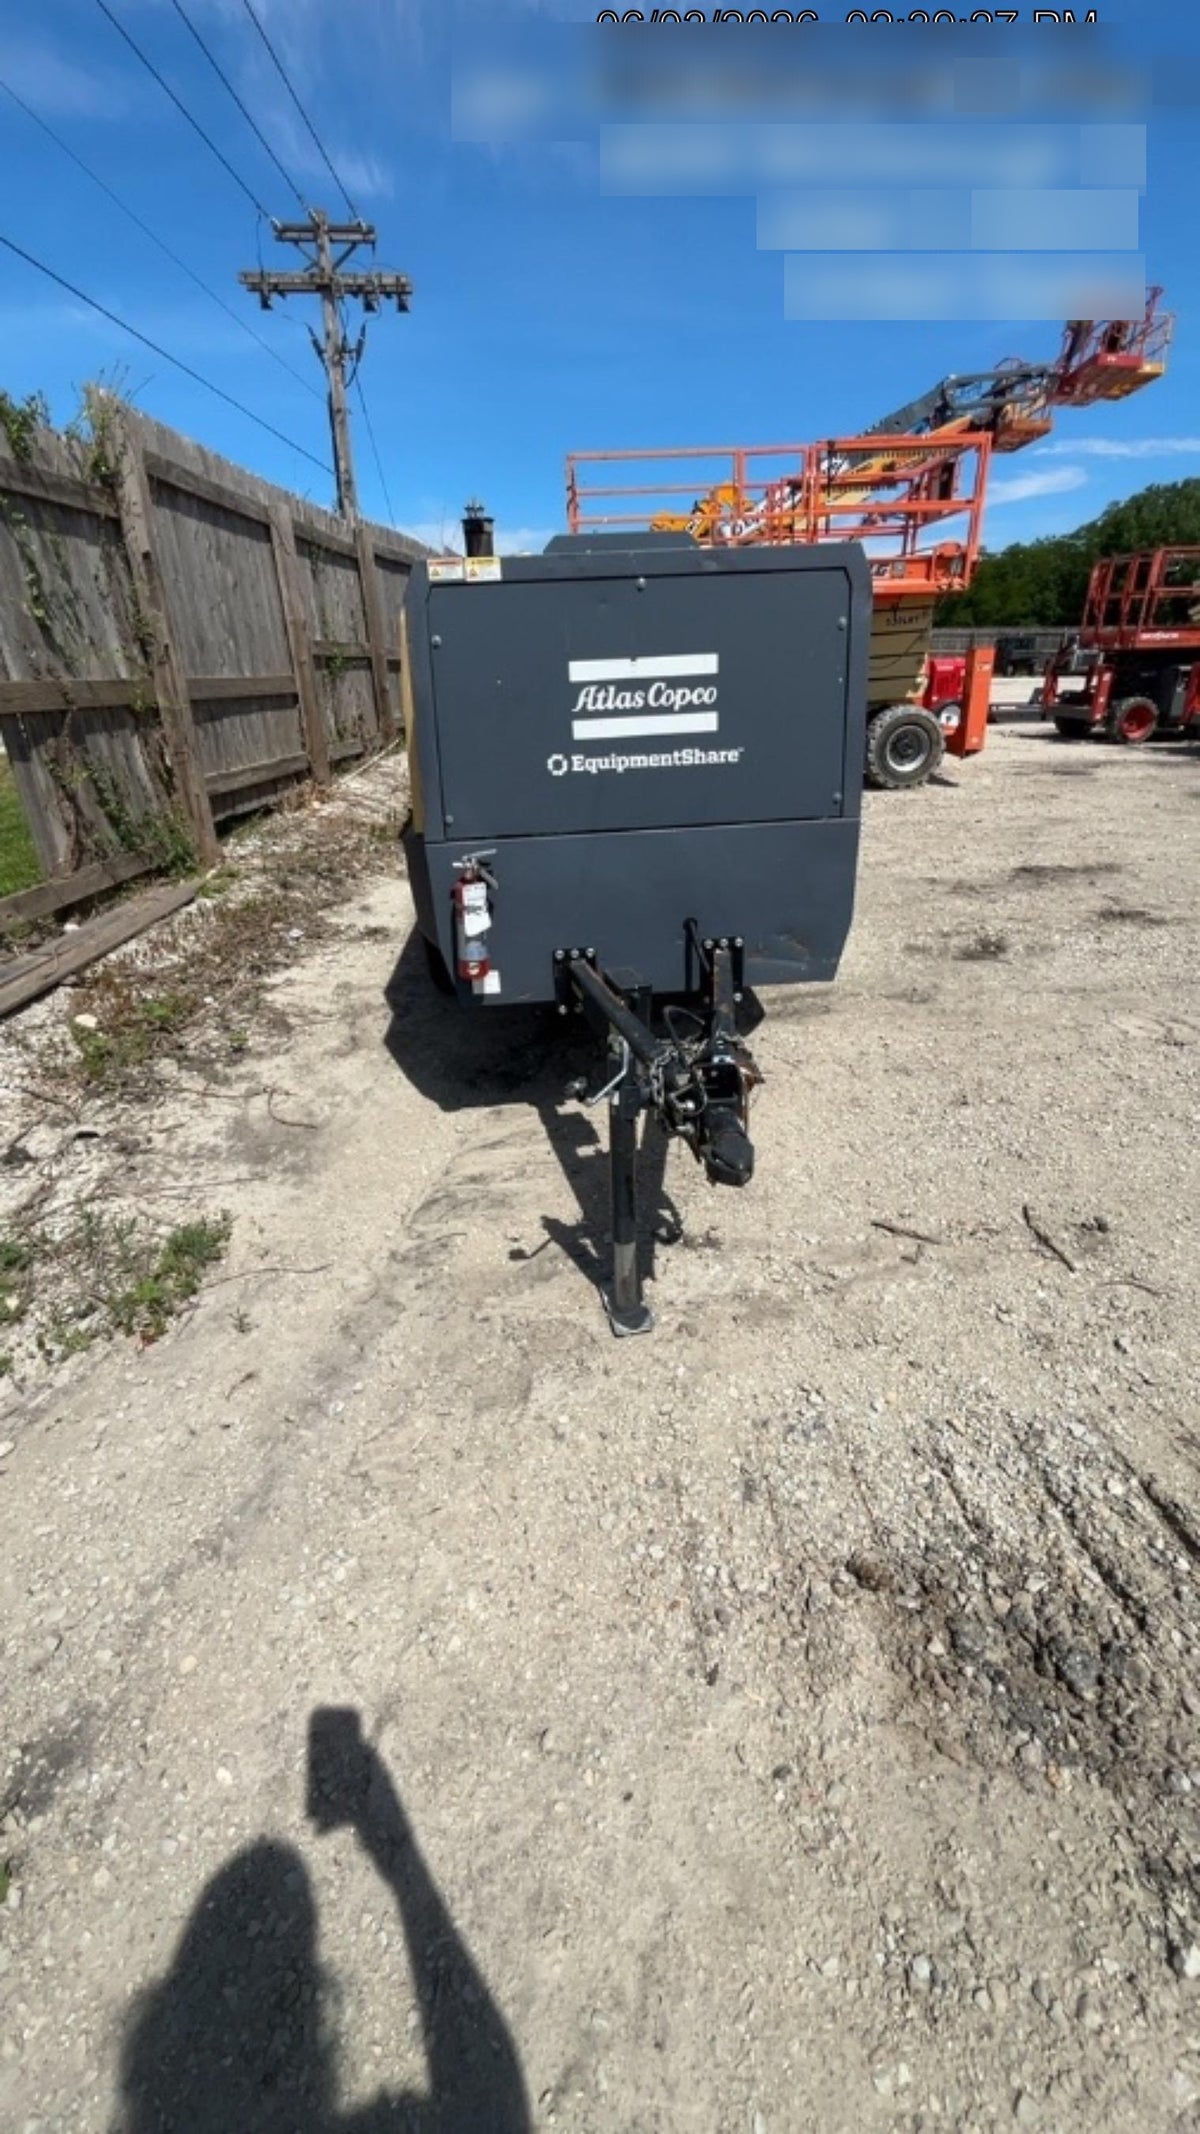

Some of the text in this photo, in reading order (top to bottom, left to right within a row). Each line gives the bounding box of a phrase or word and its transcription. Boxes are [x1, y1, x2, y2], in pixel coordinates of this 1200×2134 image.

[571, 681, 718, 712] Atlas Copco
[571, 748, 740, 774] EquipmentShare
